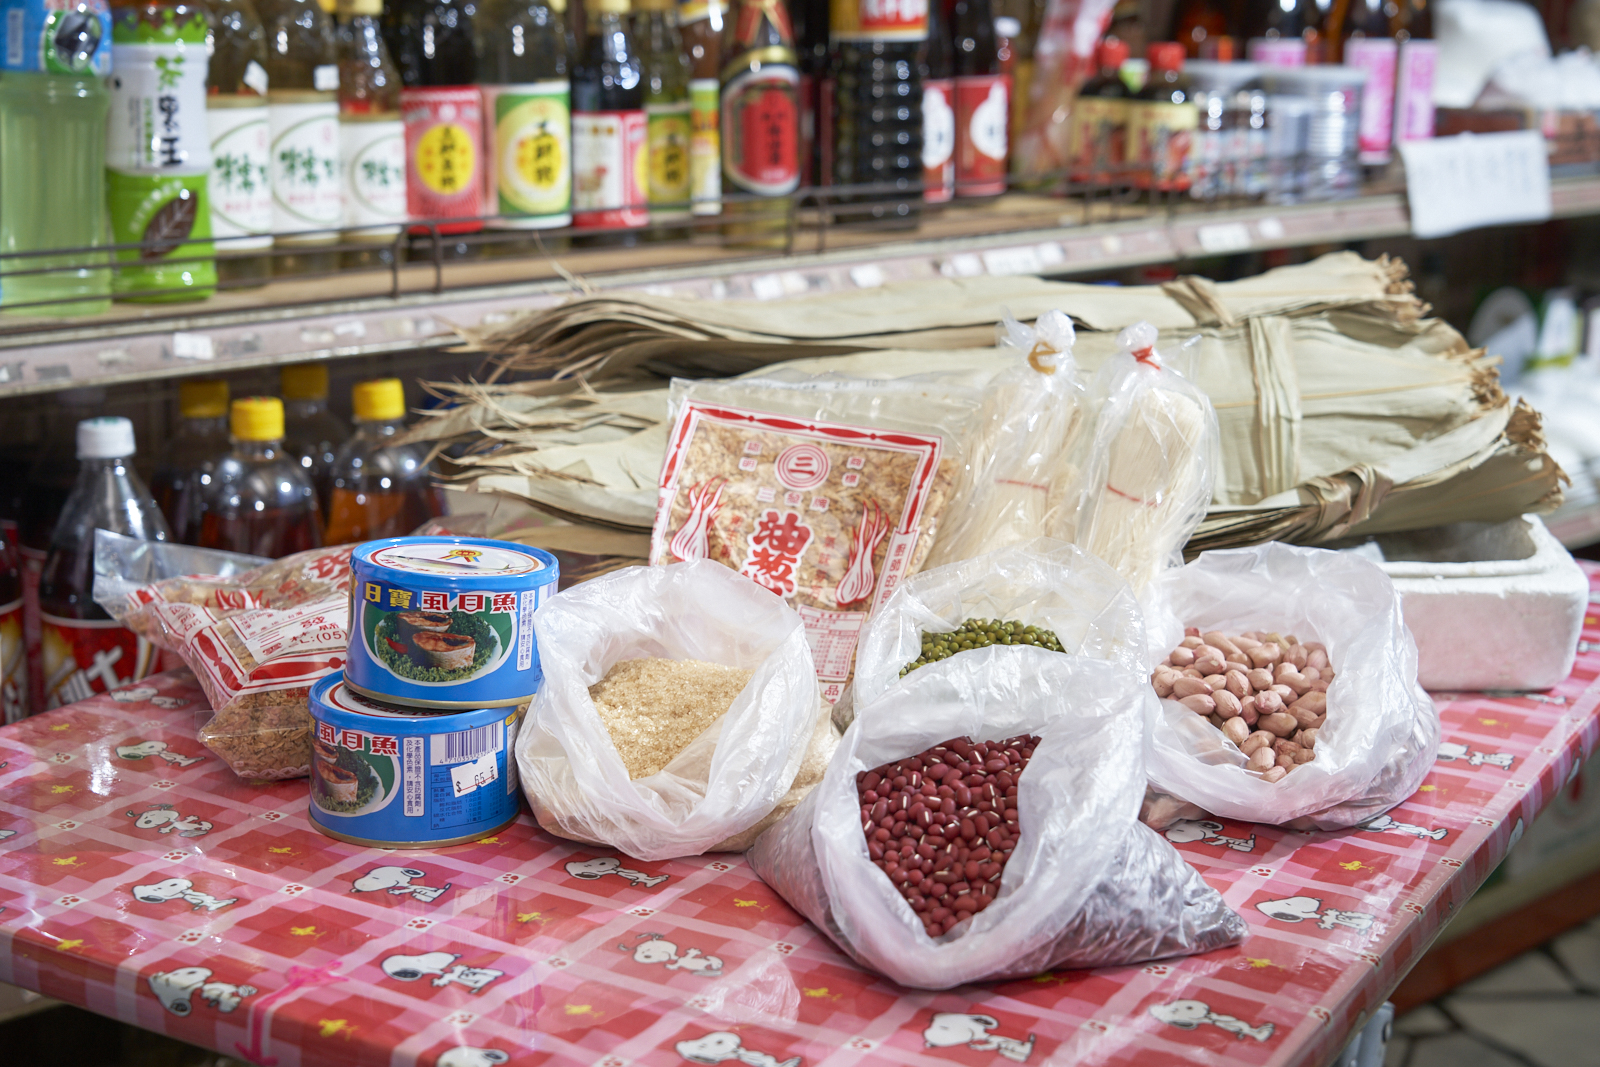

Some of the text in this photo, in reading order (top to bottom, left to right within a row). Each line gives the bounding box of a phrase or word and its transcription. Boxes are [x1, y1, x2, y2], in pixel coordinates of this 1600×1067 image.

[365, 583, 518, 613] 日寶 虱目魚
[319, 722, 399, 756] 虱目魚
